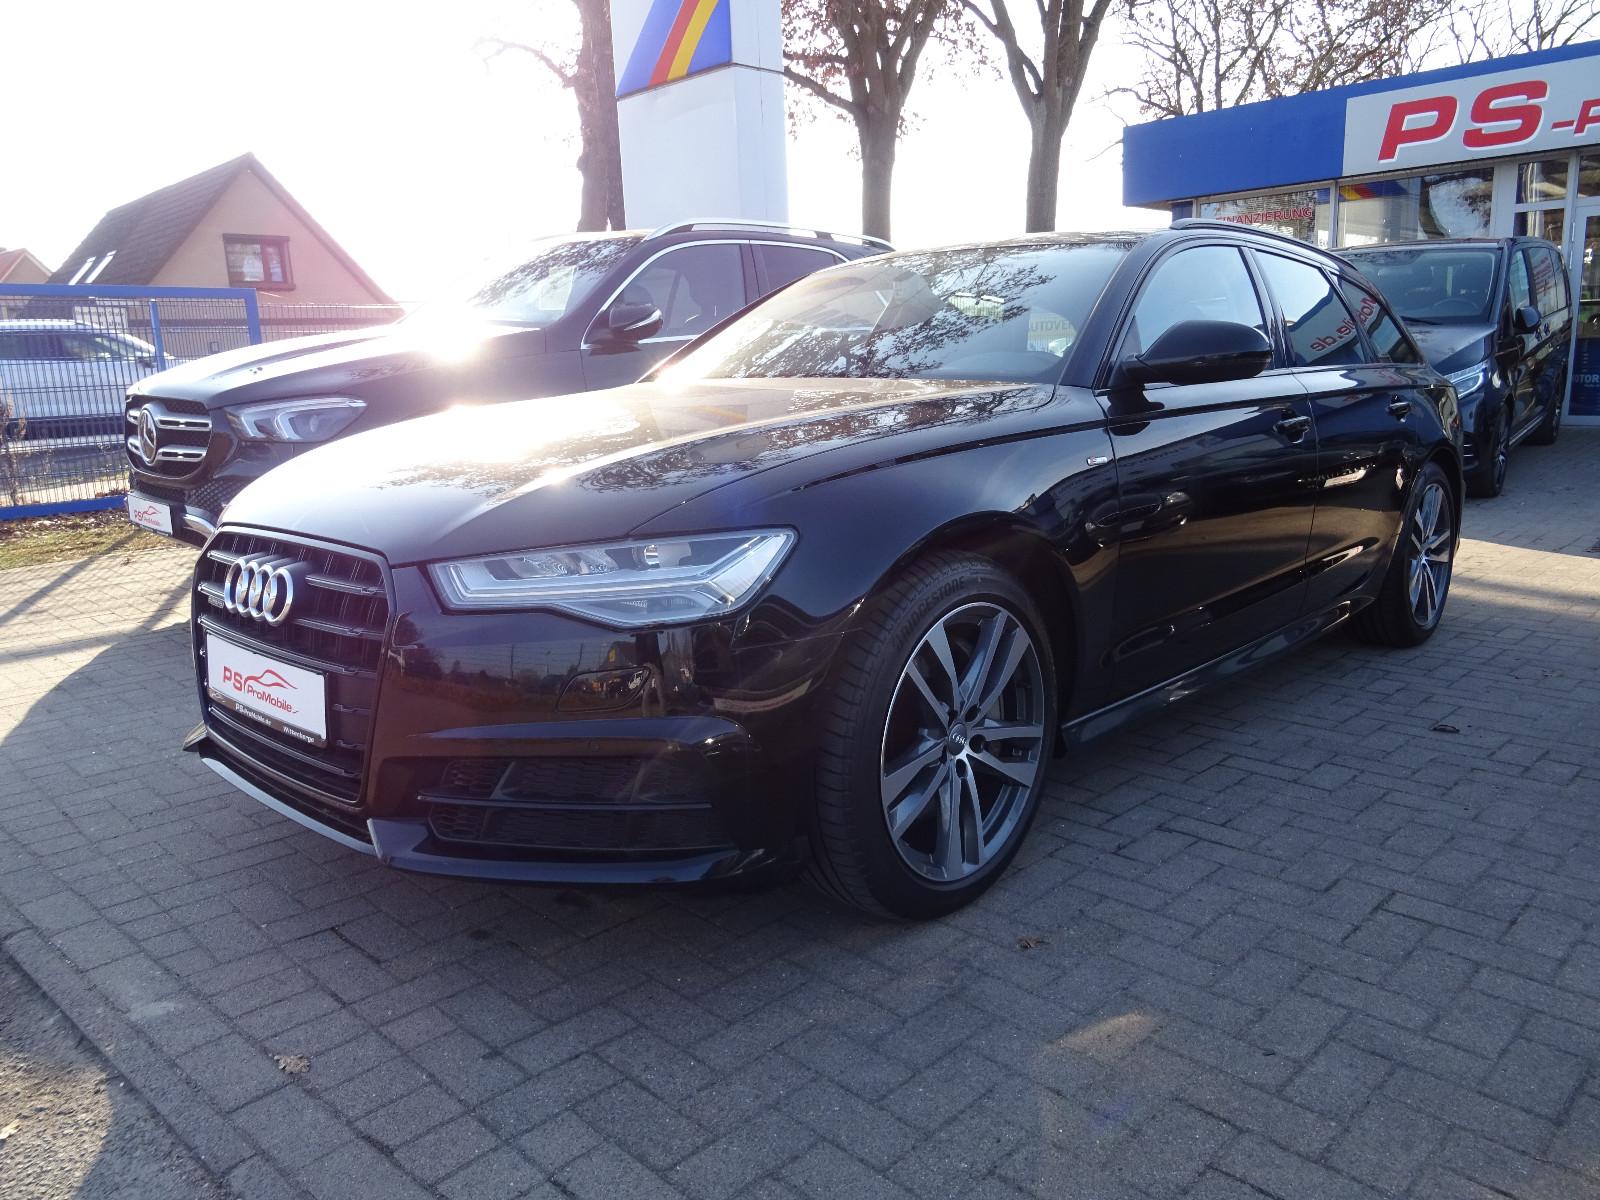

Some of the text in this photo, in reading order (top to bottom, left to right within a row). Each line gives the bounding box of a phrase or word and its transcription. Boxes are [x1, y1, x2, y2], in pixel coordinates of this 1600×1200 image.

[1216, 207, 1313, 224] NANZIERUNG
[223, 665, 293, 714] PS ProMobile
